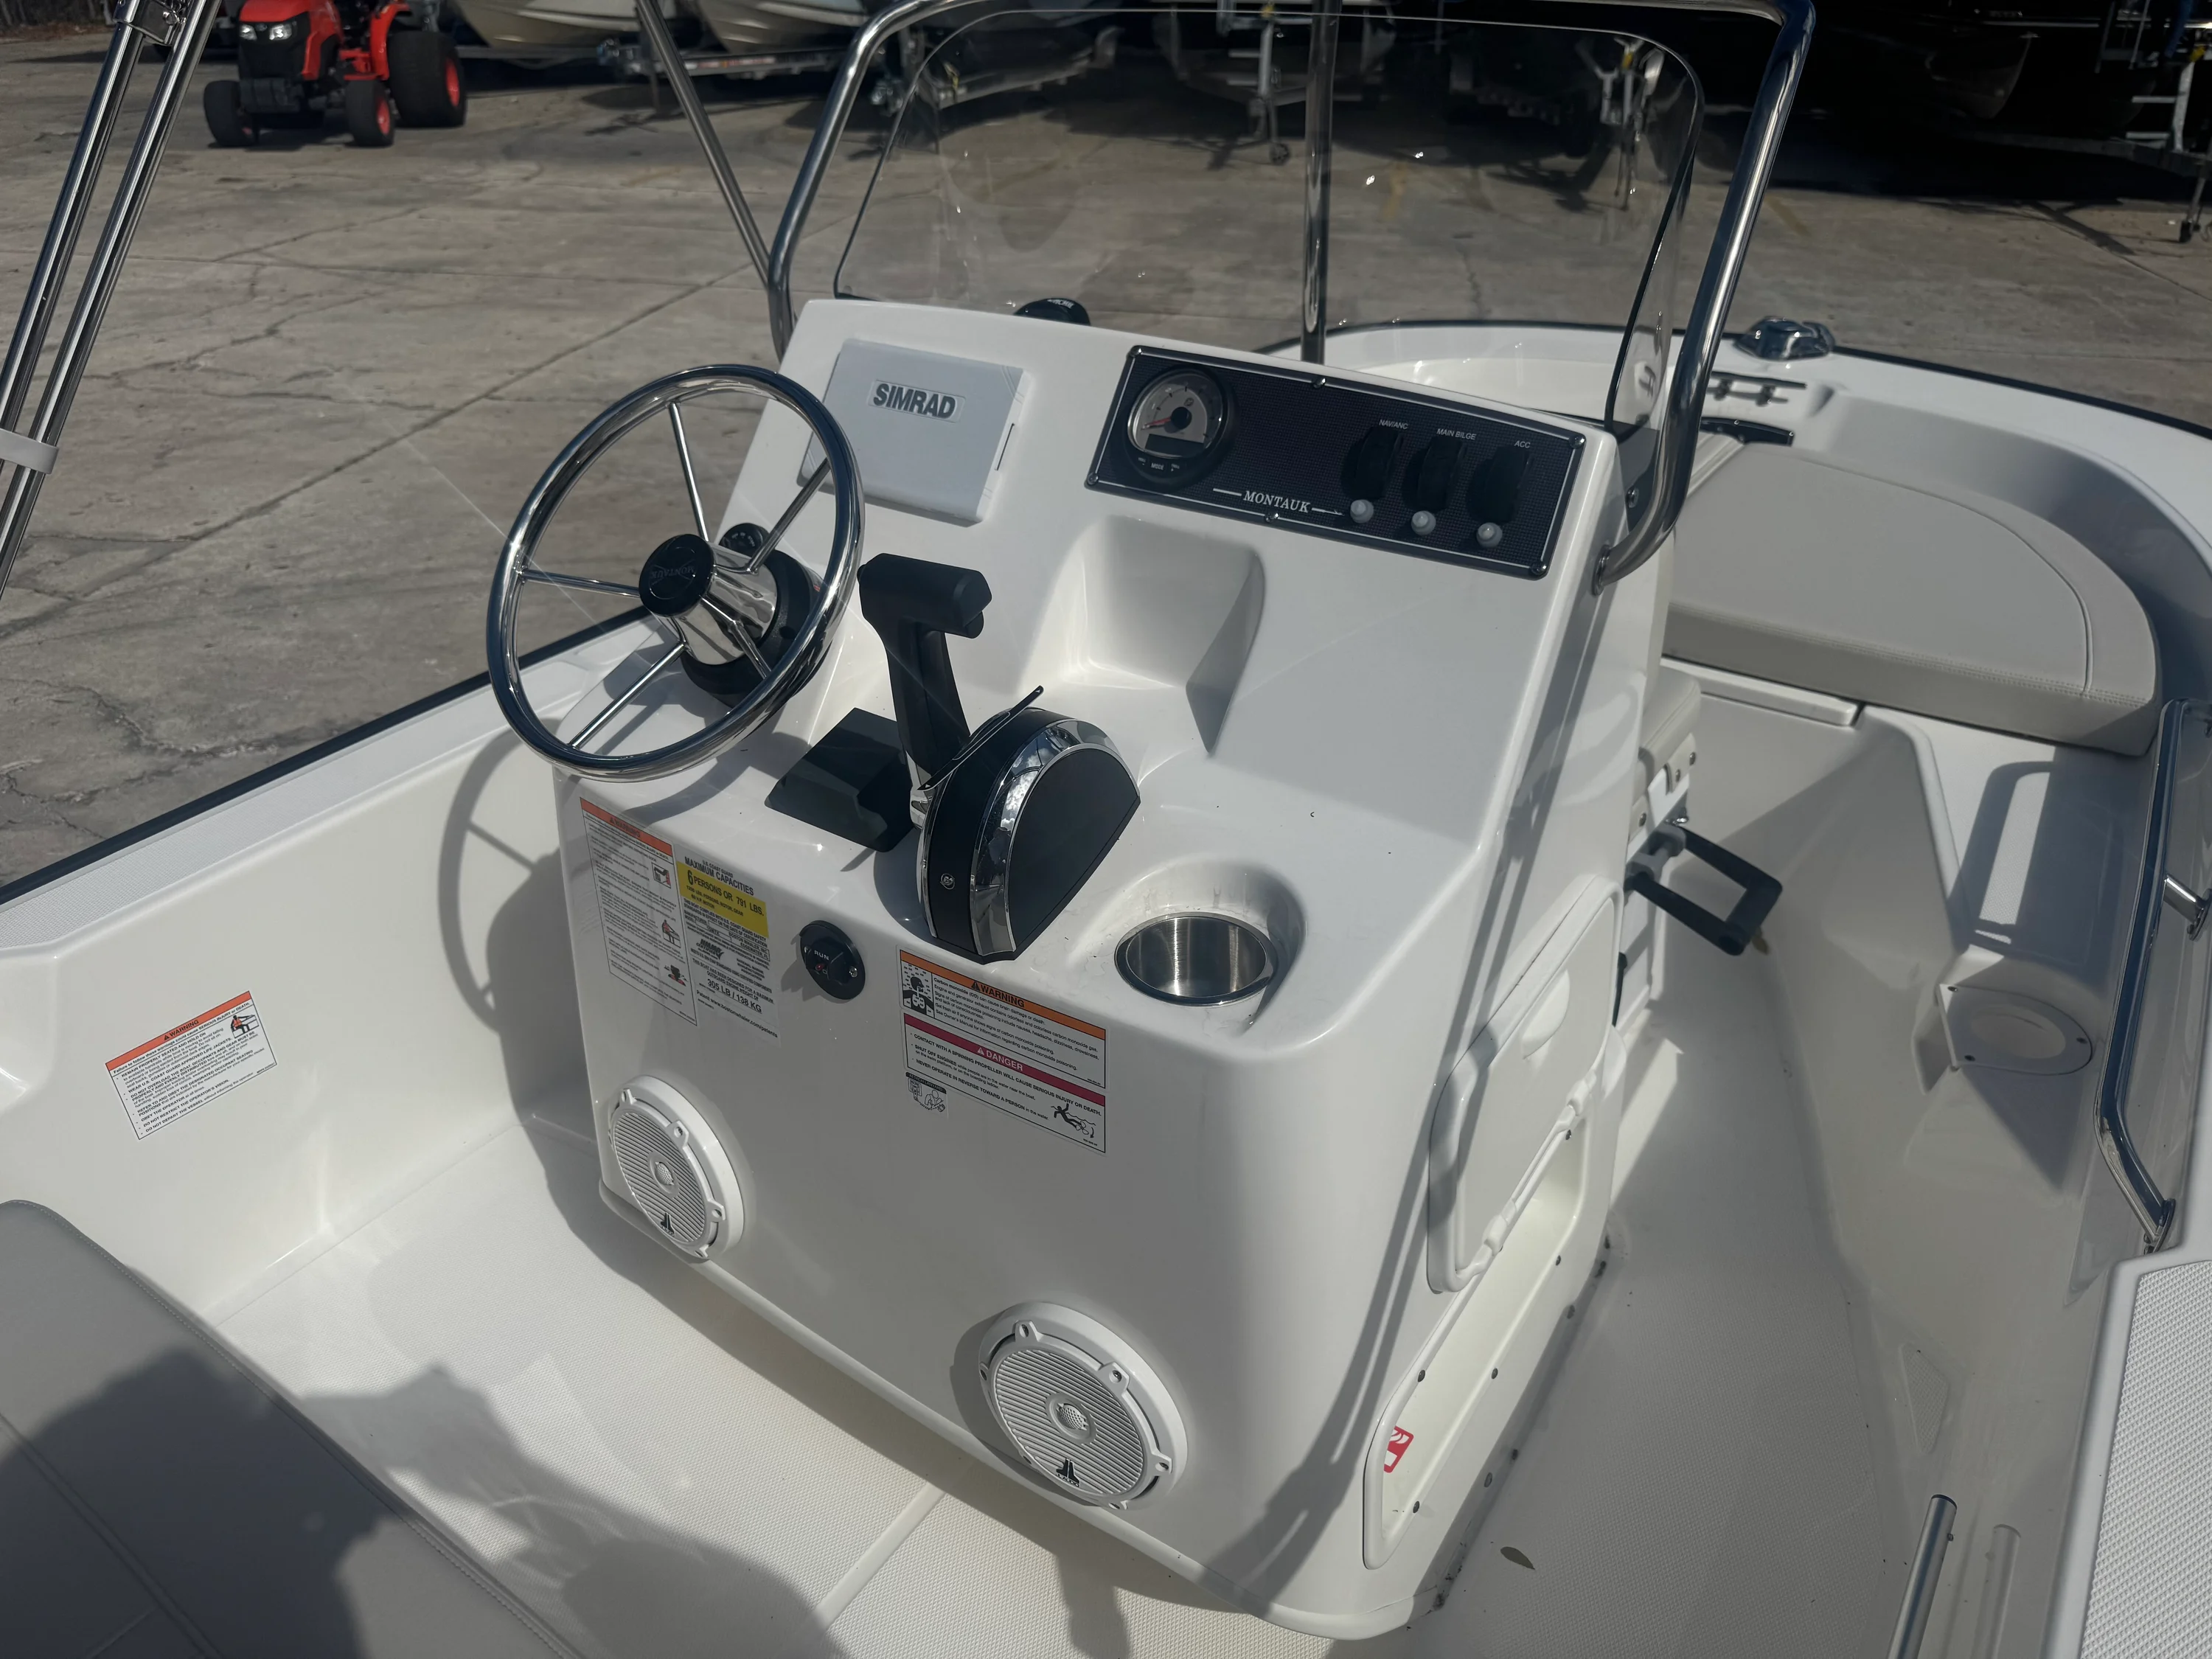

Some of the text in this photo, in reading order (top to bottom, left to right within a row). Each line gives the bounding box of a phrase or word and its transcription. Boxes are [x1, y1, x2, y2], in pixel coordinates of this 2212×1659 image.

[873, 383, 956, 419] SIMRAD
[1379, 419, 1408, 430] NAV/ANC
[1436, 428, 1477, 440] MAIN BILGE
[1514, 440, 1531, 448] ACC
[1243, 490, 1310, 512] MONTAUK
[684, 856, 754, 896] MAXIMUM CAPACITIES
[687, 869, 694, 886] 6
[694, 876, 722, 897] PERSONS
[723, 889, 733, 902] OR
[737, 896, 746, 908] 791
[814, 950, 830, 961] RUN
[707, 978, 720, 992] 305
[721, 985, 731, 997] LB
[737, 993, 749, 1006] 138
[750, 1001, 762, 1014] KG
[933, 978, 948, 988] Carbon
[949, 984, 968, 995] monoxide
[970, 991, 978, 1000] (CO)
[988, 998, 999, 1008] cause
[1000, 1004, 1009, 1012] brain
[1011, 1007, 1026, 1018] damage
[981, 984, 1025, 1009] WARNING
[169, 1019, 199, 1037] WARNING
[934, 984, 947, 994] Engine
[956, 992, 973, 1004] generator
[975, 1000, 989, 1010] exhaust
[990, 1006, 1006, 1017] contains
[1007, 1013, 1024, 1024] odorless
[1034, 1023, 1051, 1035] colorless
[1053, 1031, 1066, 1041] carbon
[1068, 1037, 1088, 1049] monoxide
[914, 1034, 935, 1047] CONTACT
[936, 1043, 947, 1052] WITH
[953, 1050, 973, 1063] SPINNING
[975, 1060, 1002, 1076] PROPELLER
[1004, 1071, 1015, 1081] WILL
[1016, 1077, 1032, 1088] CAUSE
[1033, 1084, 1054, 1097] SERIOUS
[1056, 1093, 1073, 1105] INJURY
[987, 1050, 1023, 1071] DANGER
[917, 1059, 931, 1069] NEVER
[932, 1065, 952, 1079] OPERATE
[959, 1077, 979, 1091] REVERSE
[980, 1087, 1000, 1100] TOWARD
[1006, 1098, 1025, 1110] PERSON
